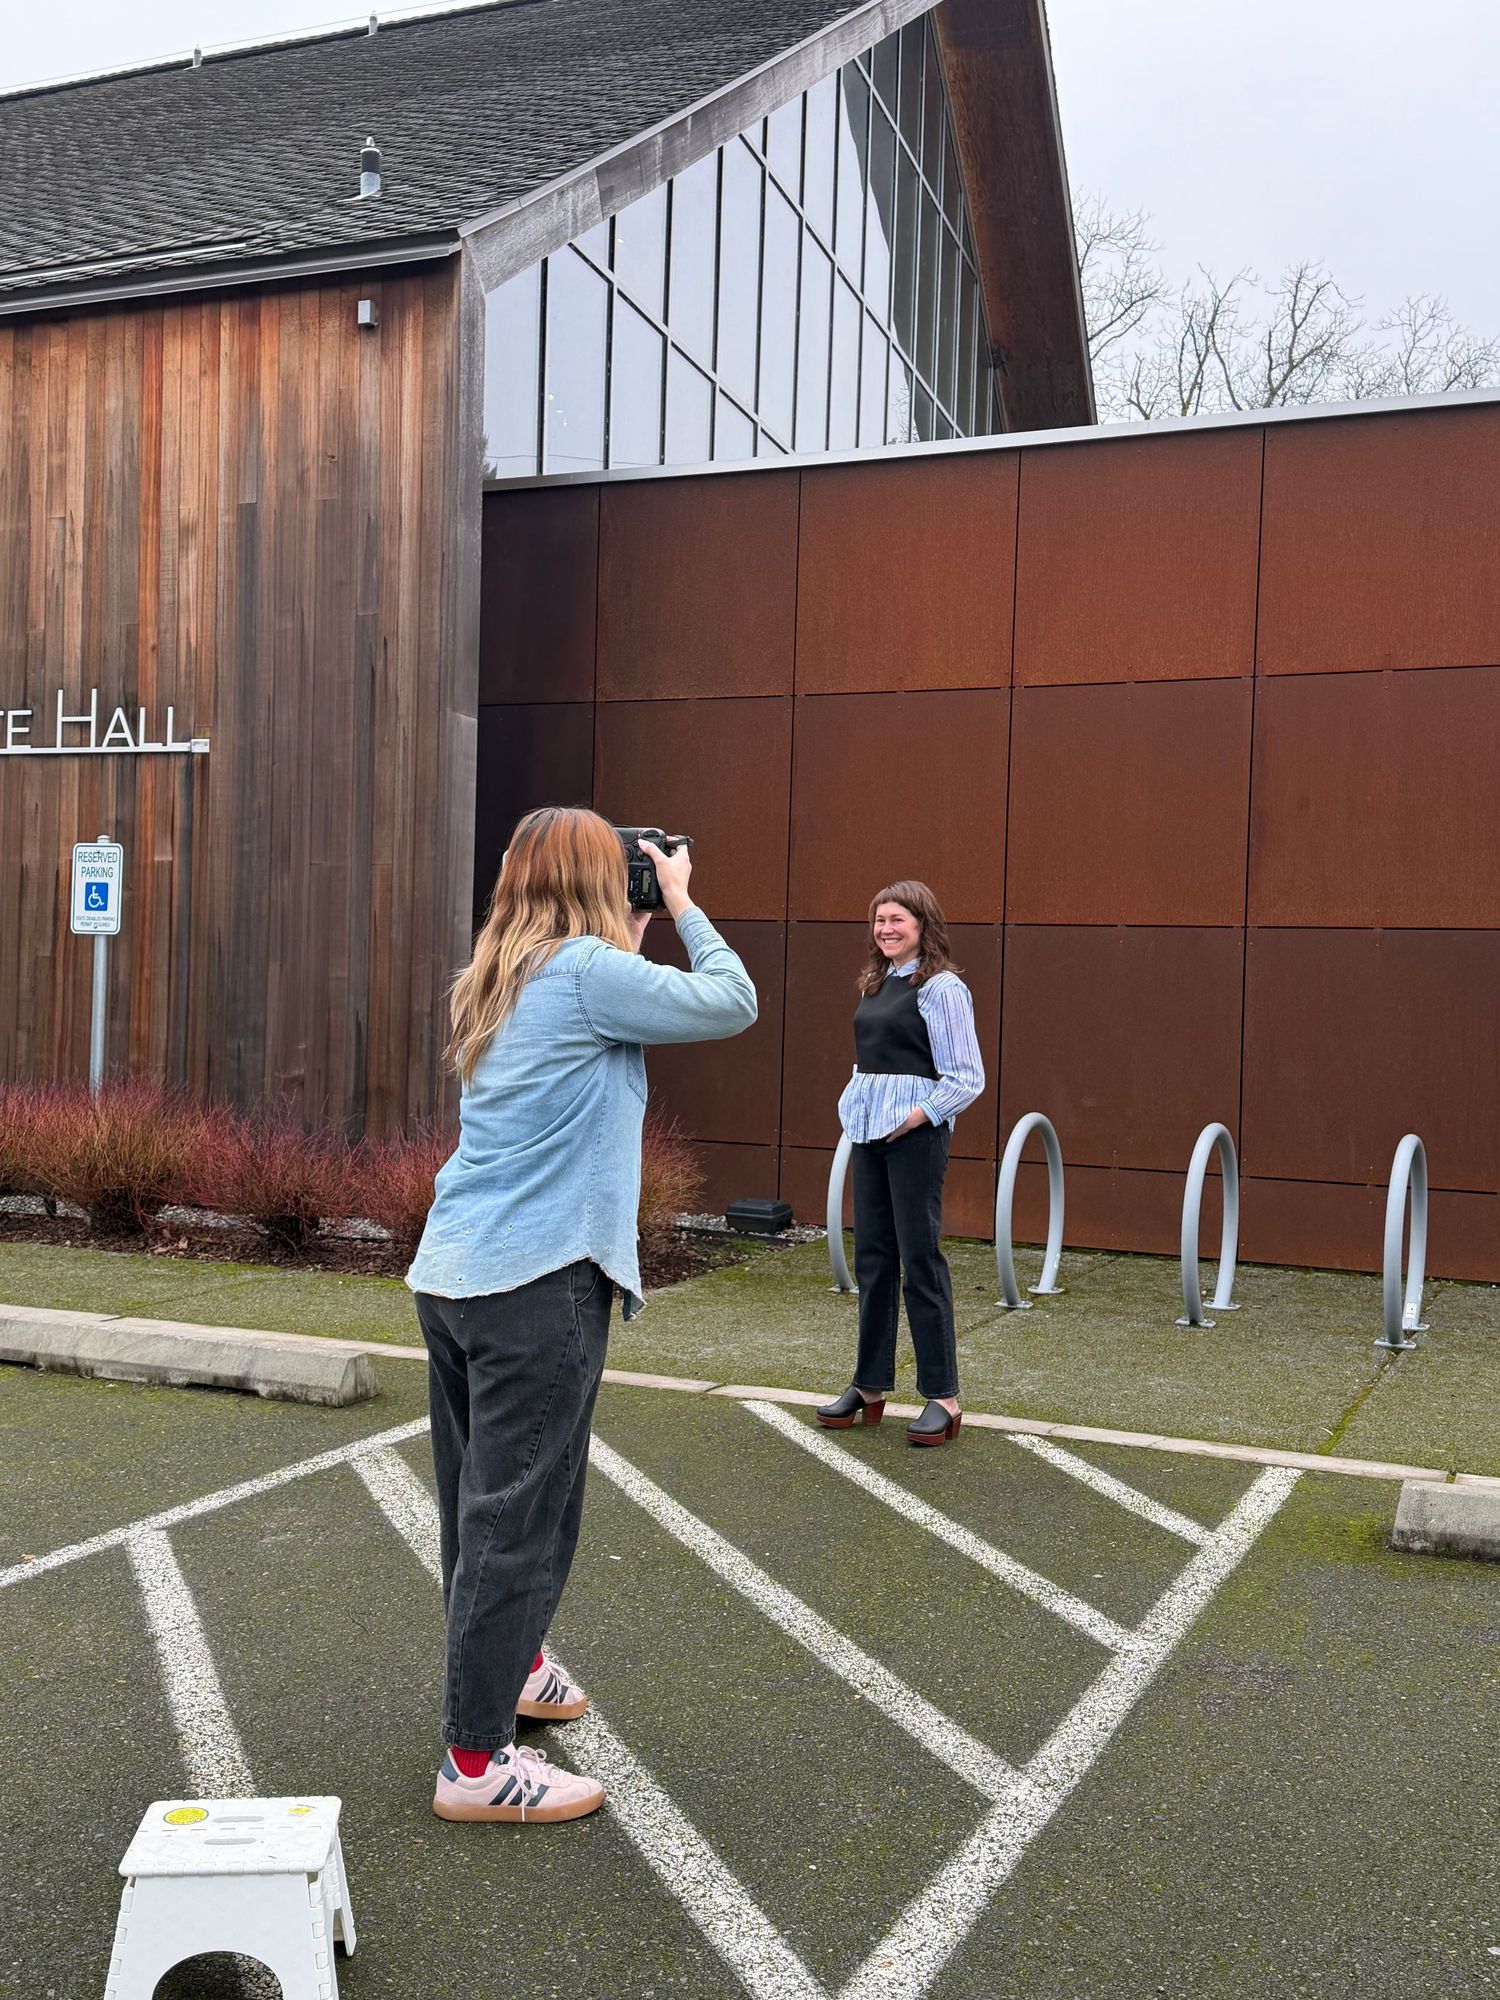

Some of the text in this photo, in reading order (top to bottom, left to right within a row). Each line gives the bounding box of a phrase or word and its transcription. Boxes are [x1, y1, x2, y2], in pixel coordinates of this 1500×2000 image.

[0, 688, 191, 749] E HALL
[78, 851, 118, 863] RESERVED
[81, 866, 114, 878] PARKING
